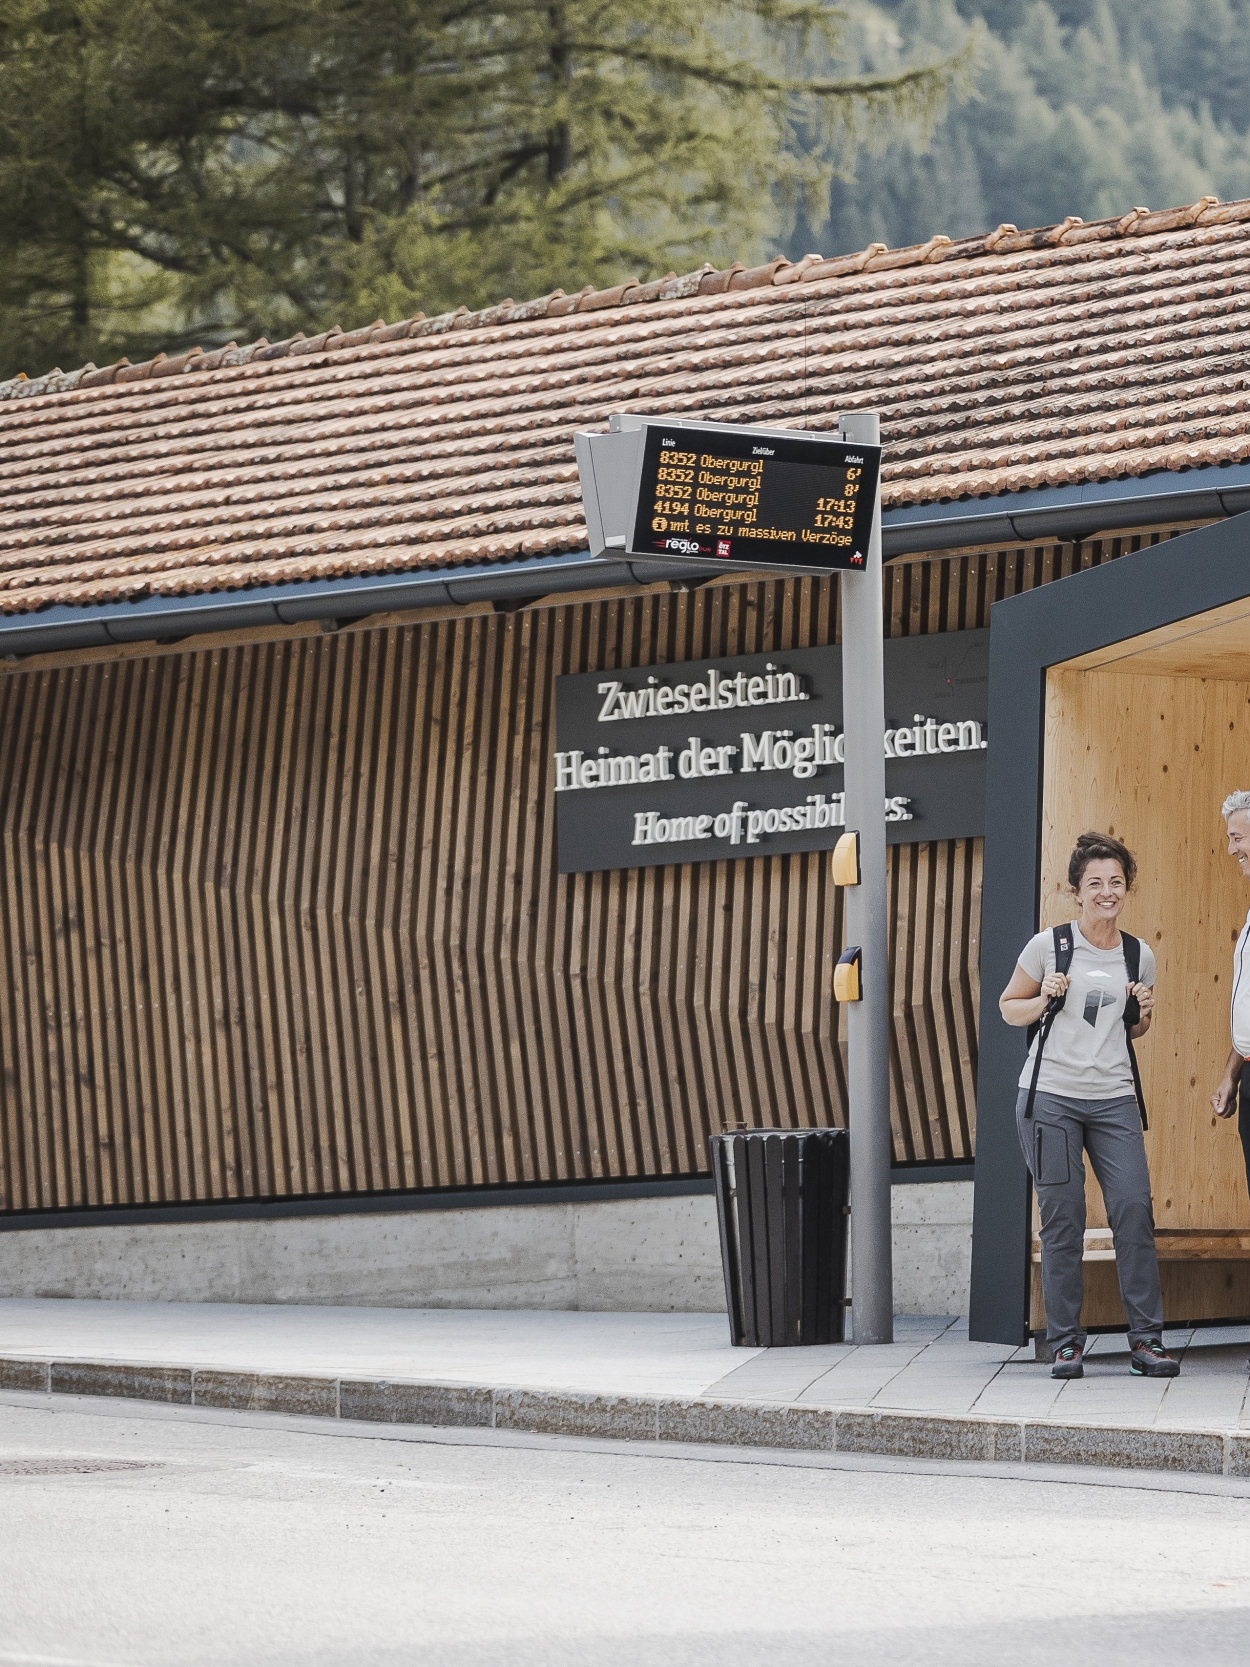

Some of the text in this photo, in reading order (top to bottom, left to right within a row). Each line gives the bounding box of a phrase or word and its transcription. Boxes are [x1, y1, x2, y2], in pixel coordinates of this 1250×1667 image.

[660, 451, 697, 466] 8352
[700, 454, 764, 475] Obergurgl
[662, 438, 676, 447] Linie
[844, 455, 864, 464] Abfahrt
[657, 467, 694, 483] 8352
[698, 471, 761, 491] Obergurgl
[655, 484, 856, 513] 8352 Obergurgl 17:13
[653, 500, 854, 529] 4194 Obergurgl 17:43
[665, 539, 699, 553] regio
[696, 523, 711, 534] es
[717, 525, 733, 536] zu
[738, 527, 797, 541] massiven
[801, 529, 853, 546] Verzöge
[597, 662, 810, 722] Zwieselstein.
[553, 713, 988, 791] Heimat der Möglickeiten.
[631, 811, 713, 845] Home
[713, 801, 748, 845] of
